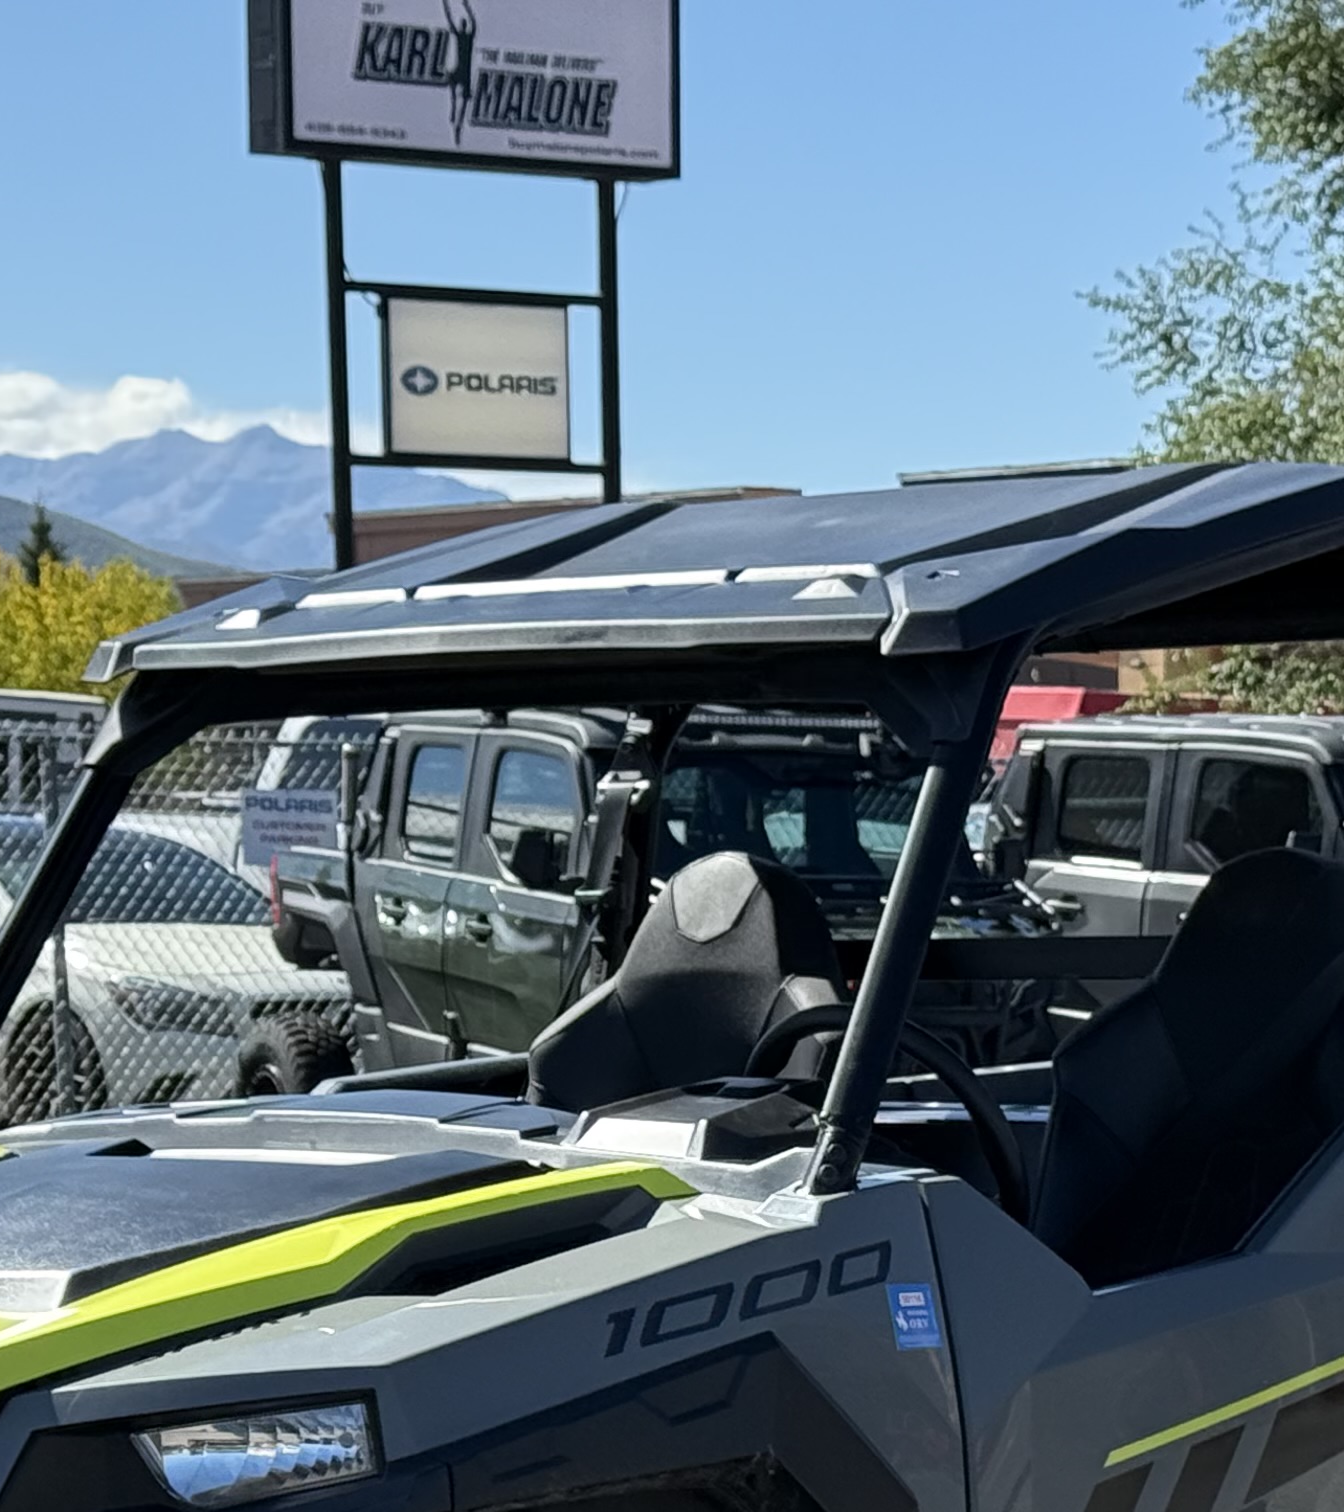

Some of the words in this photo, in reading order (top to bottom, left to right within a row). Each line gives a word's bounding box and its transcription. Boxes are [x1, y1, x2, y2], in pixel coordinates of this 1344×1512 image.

[352, 21, 449, 86] KARL
[469, 67, 619, 137] MALONE
[445, 371, 558, 396] POLARIS
[244, 795, 333, 814] POLARIS
[604, 1239, 892, 1358] 1000
